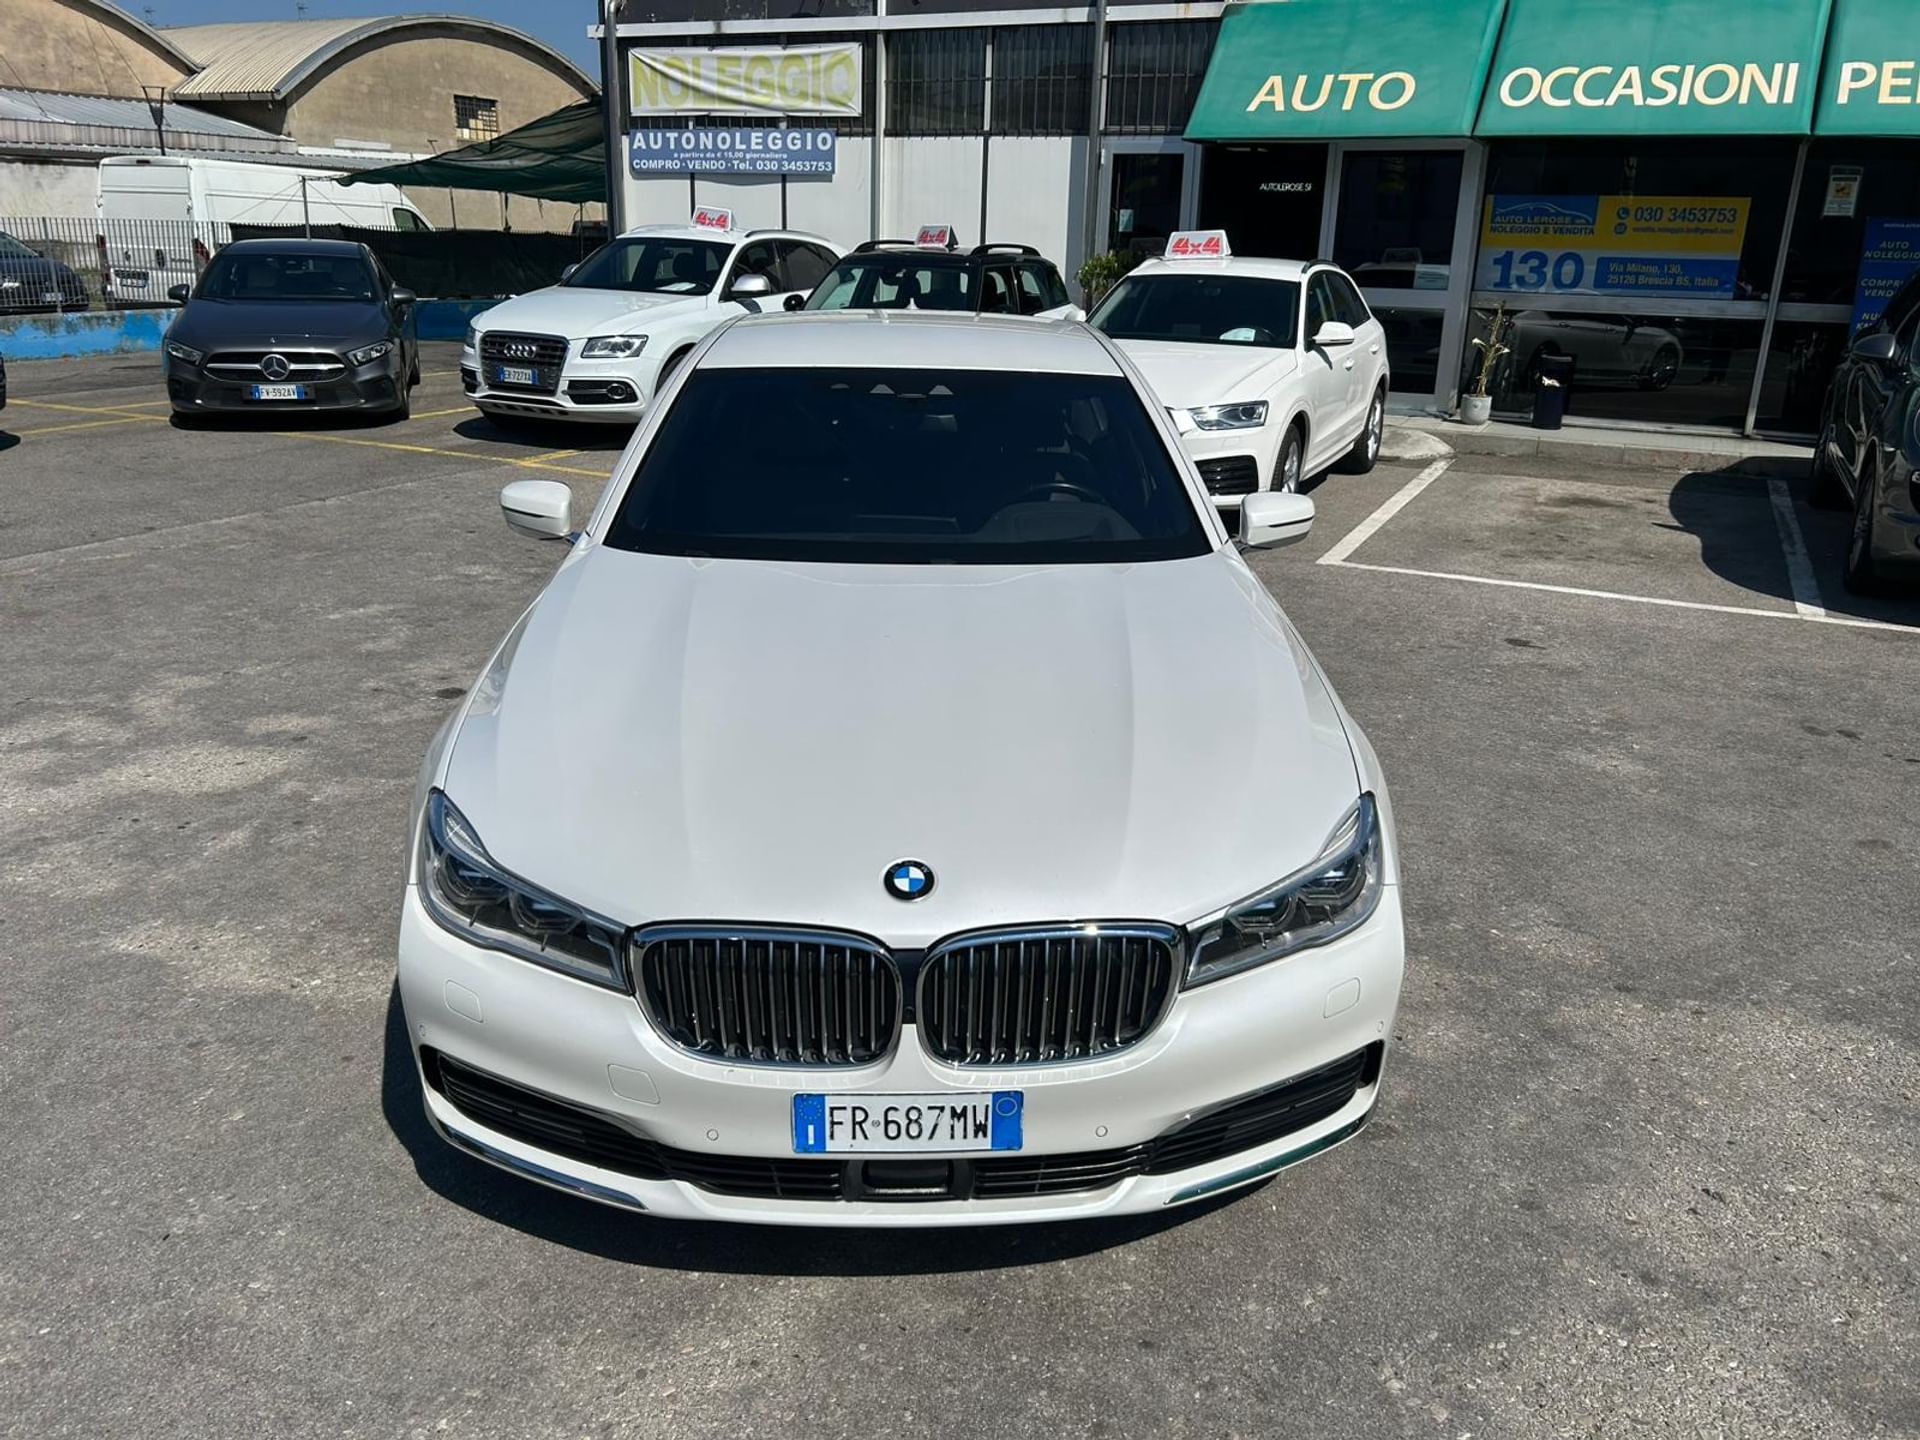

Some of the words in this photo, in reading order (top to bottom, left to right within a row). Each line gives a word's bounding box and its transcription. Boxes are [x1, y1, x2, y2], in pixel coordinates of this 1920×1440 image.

[632, 52, 857, 108] NOLEGGIO
[1246, 71, 1416, 112] AUTO
[1499, 62, 1800, 107] OCCASIONI
[1836, 61, 1920, 105] PE
[633, 132, 832, 150] AUTONOLEGGIO
[633, 159, 680, 169] COMPRO
[687, 159, 726, 170] VENDO
[732, 160, 752, 170] Tel.
[756, 161, 778, 171] 030
[782, 161, 832, 171] 3453753
[695, 211, 729, 230] 4x4
[1494, 215, 1524, 224] AUTO
[1633, 206, 1663, 221] 030
[1667, 207, 1738, 223] 3453753
[1490, 224, 1541, 234] NOLEGGIO
[1171, 236, 1220, 255] 4x4
[1880, 240, 1909, 250] AUTO
[1493, 250, 1584, 289] 130
[1608, 262, 1624, 273] Via
[1638, 275, 1673, 285] Brescia
[1860, 278, 1904, 288] COMPR
